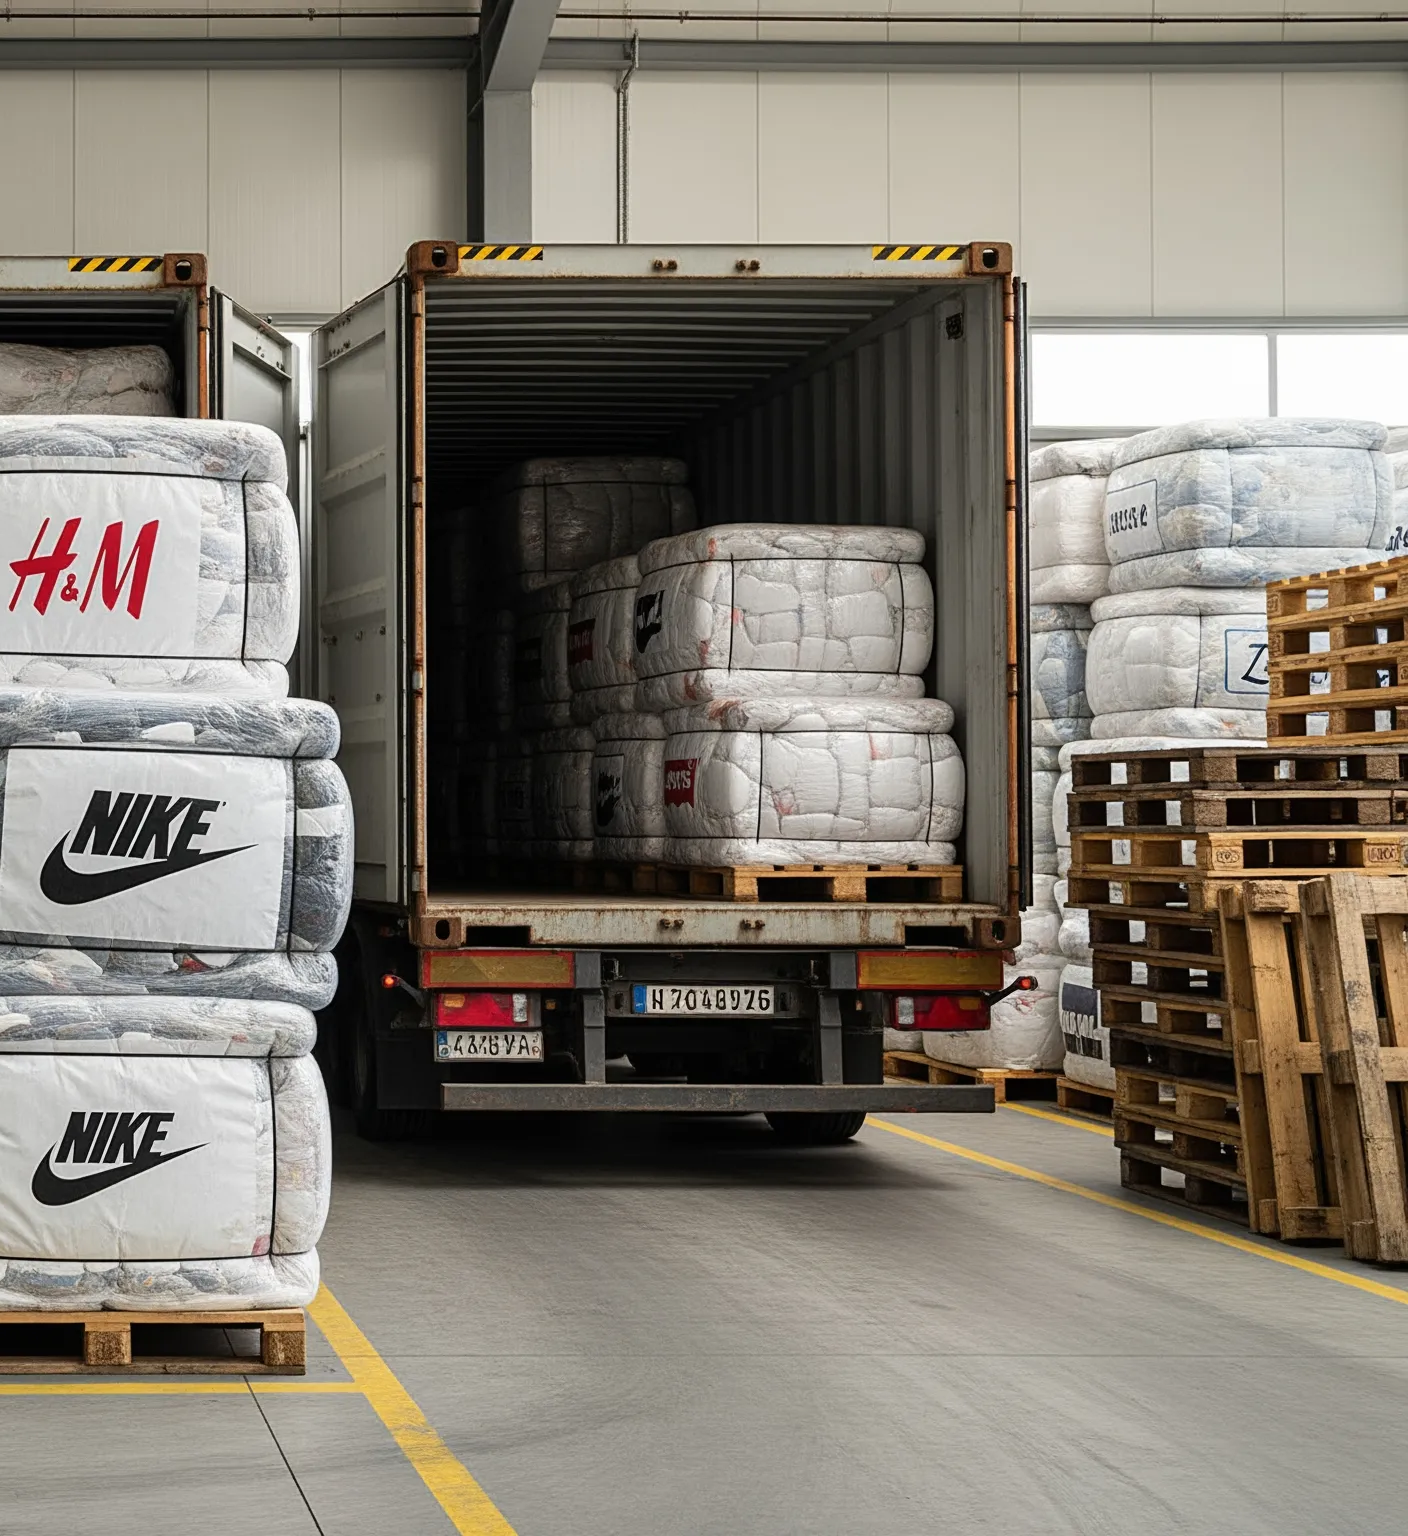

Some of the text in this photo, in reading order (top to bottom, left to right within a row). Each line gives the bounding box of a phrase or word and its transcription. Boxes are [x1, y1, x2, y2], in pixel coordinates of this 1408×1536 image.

[8, 516, 159, 621] H&M
[68, 789, 221, 860] NIKE
[54, 1111, 176, 1164] NIKE
